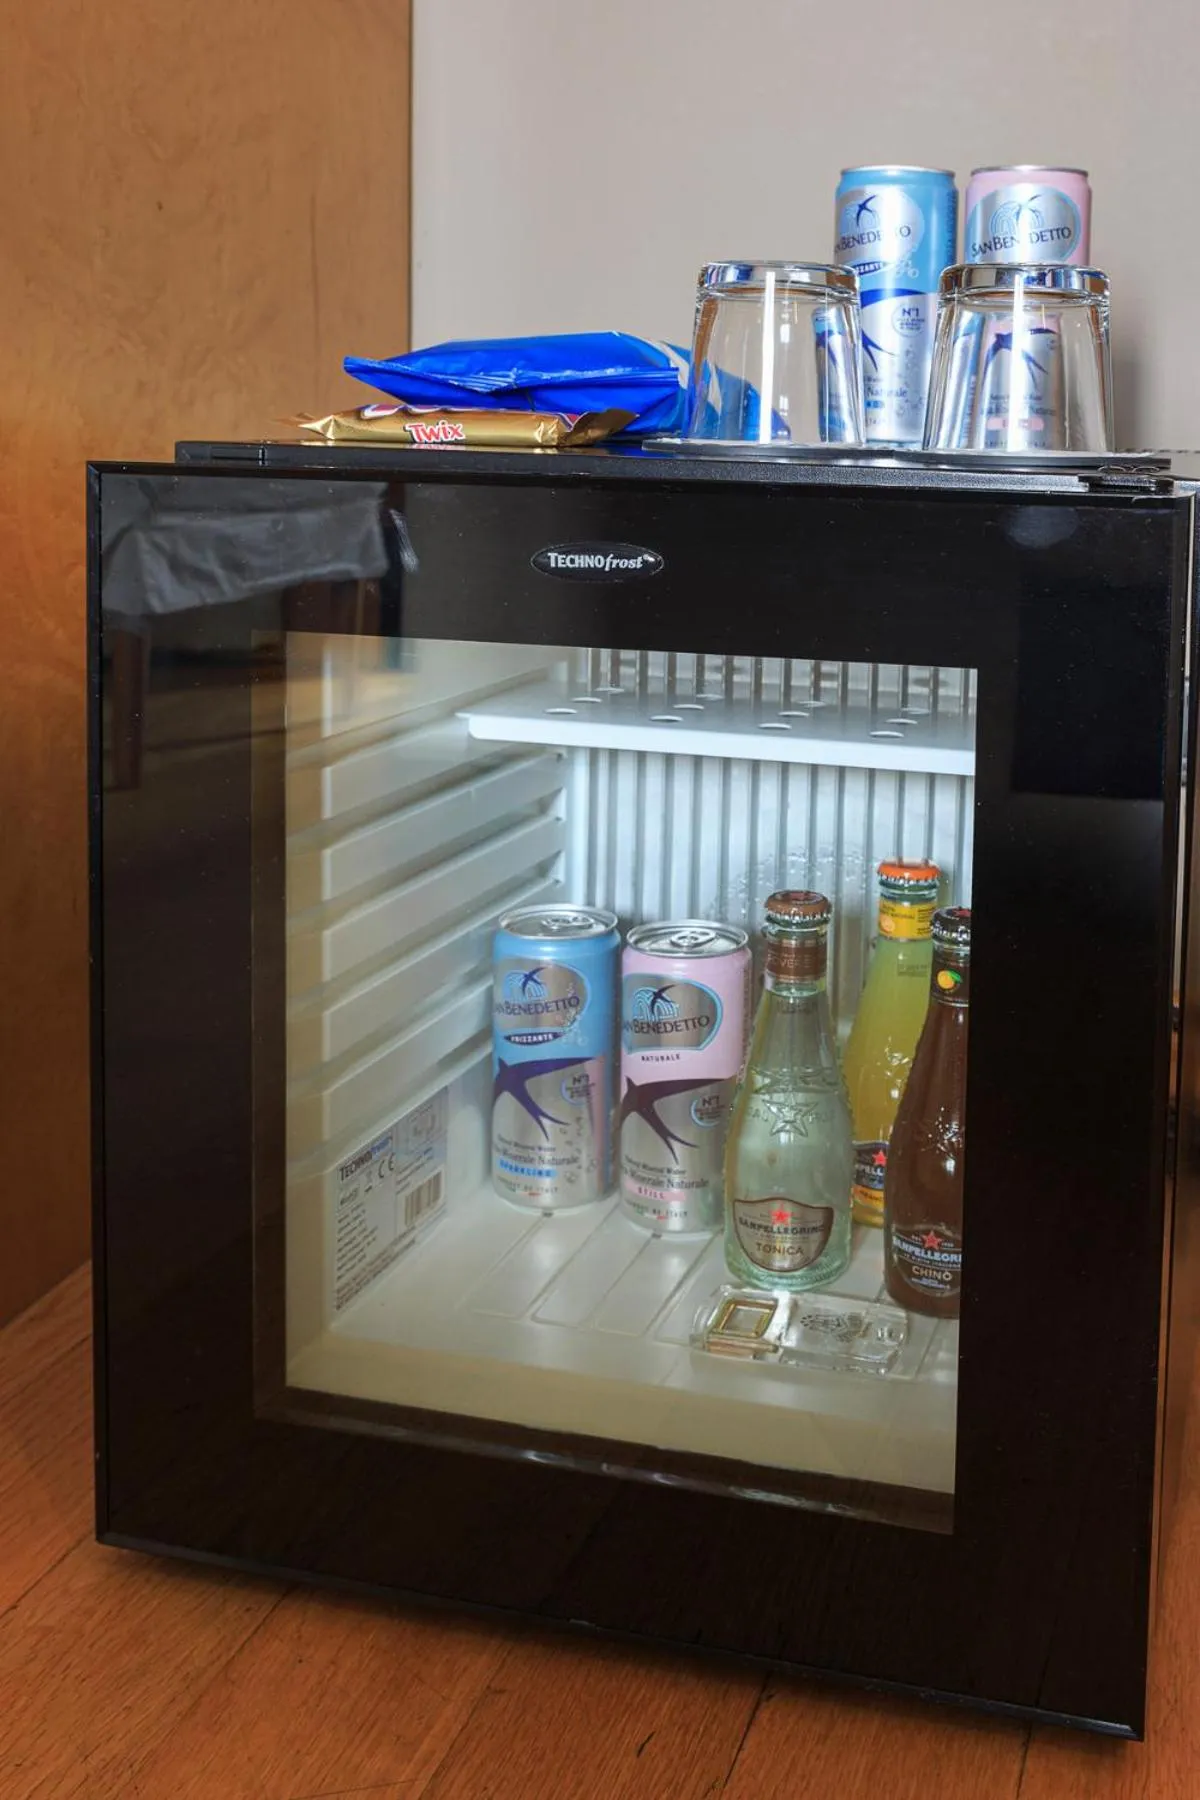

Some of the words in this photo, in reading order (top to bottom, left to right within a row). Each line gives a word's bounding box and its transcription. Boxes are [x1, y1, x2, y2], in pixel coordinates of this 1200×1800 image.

[406, 422, 465, 443] Twix
[547, 552, 644, 571] TECHNOfrost
[510, 1033, 553, 1043] FRIZZANTE
[641, 1054, 681, 1063] NATURALE
[755, 1242, 805, 1255] TONICA
